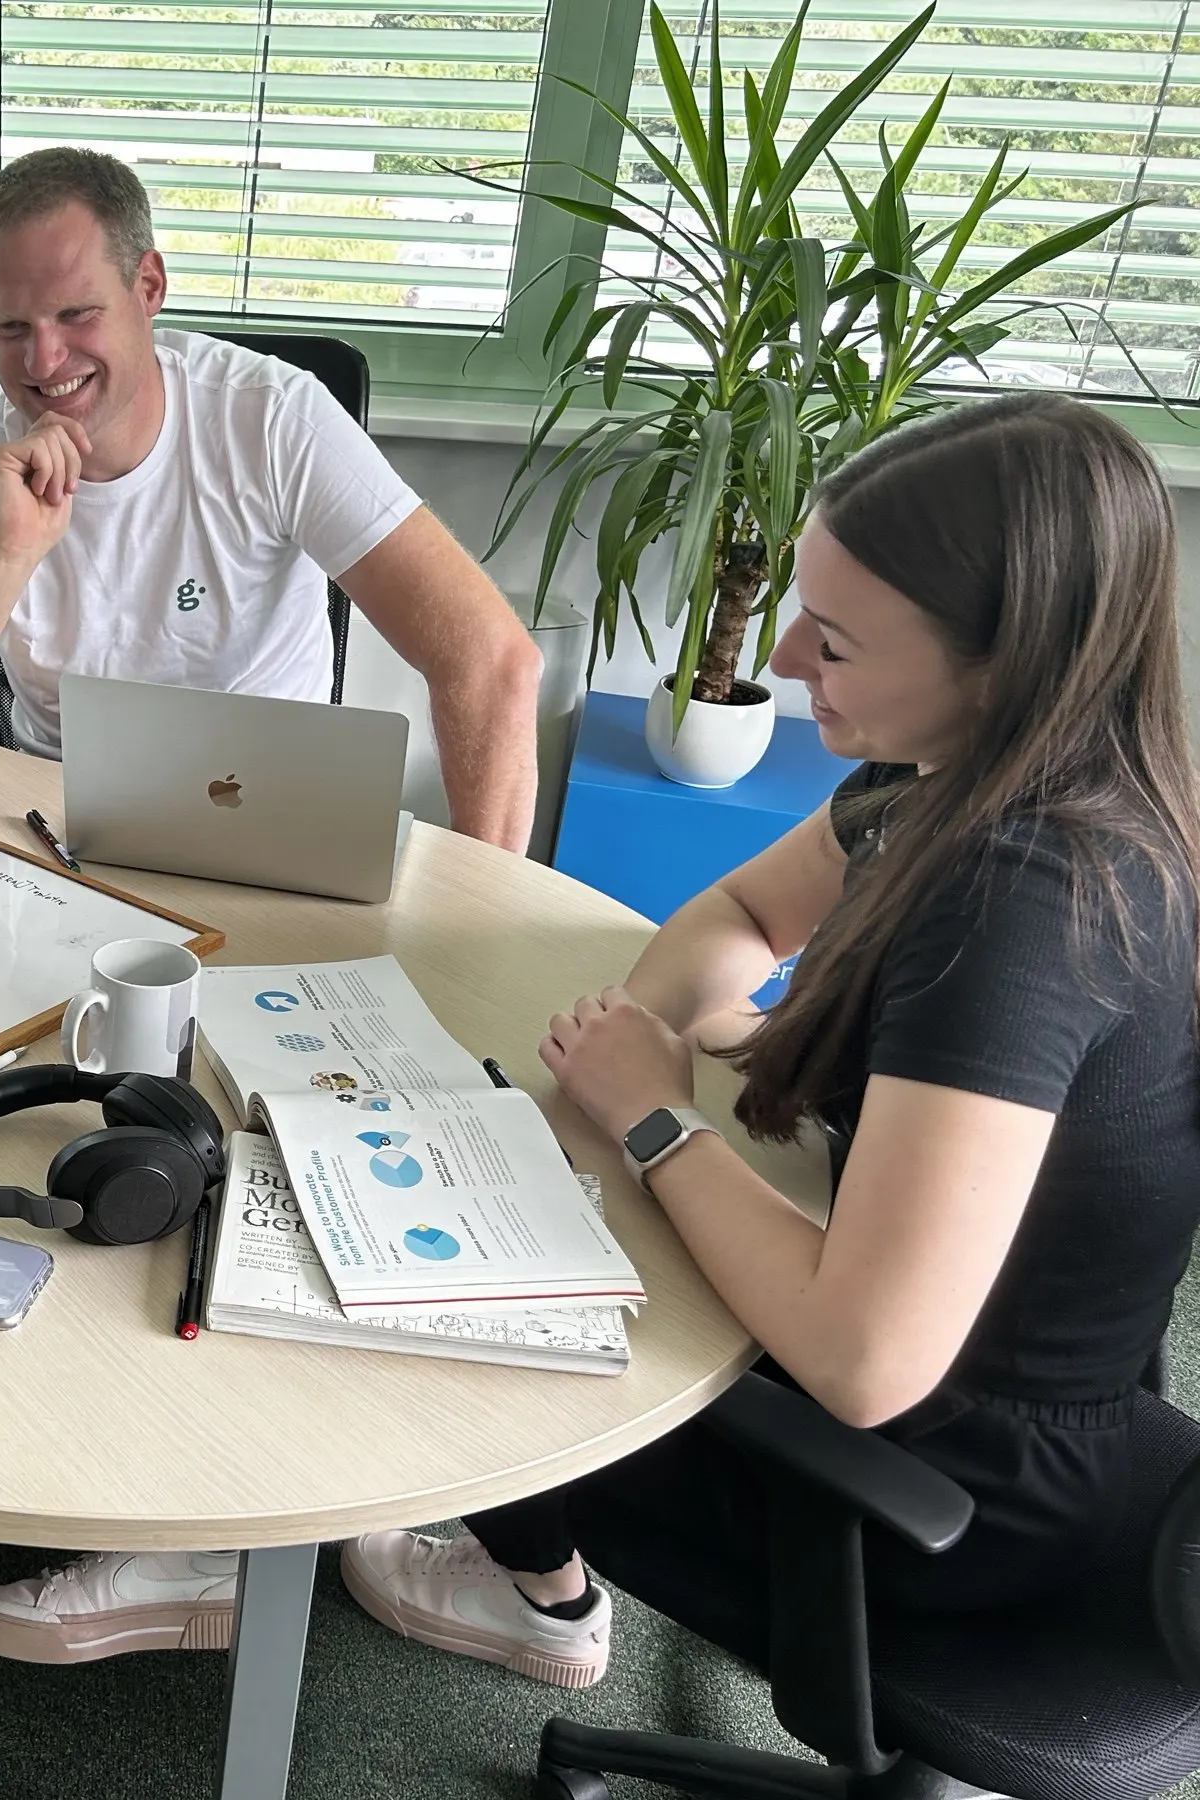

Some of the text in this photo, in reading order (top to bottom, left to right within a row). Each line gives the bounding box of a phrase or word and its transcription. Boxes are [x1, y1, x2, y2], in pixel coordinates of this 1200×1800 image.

[310, 1149, 366, 1266] from the Customer Profile
[305, 1173, 351, 1266] Six Ways to Innovate
[241, 1231, 283, 1242] WRITTEN
[239, 1243, 299, 1258] CO-CREATED
[302, 1253, 314, 1261] BY
[237, 1257, 285, 1269] DESIGNED
